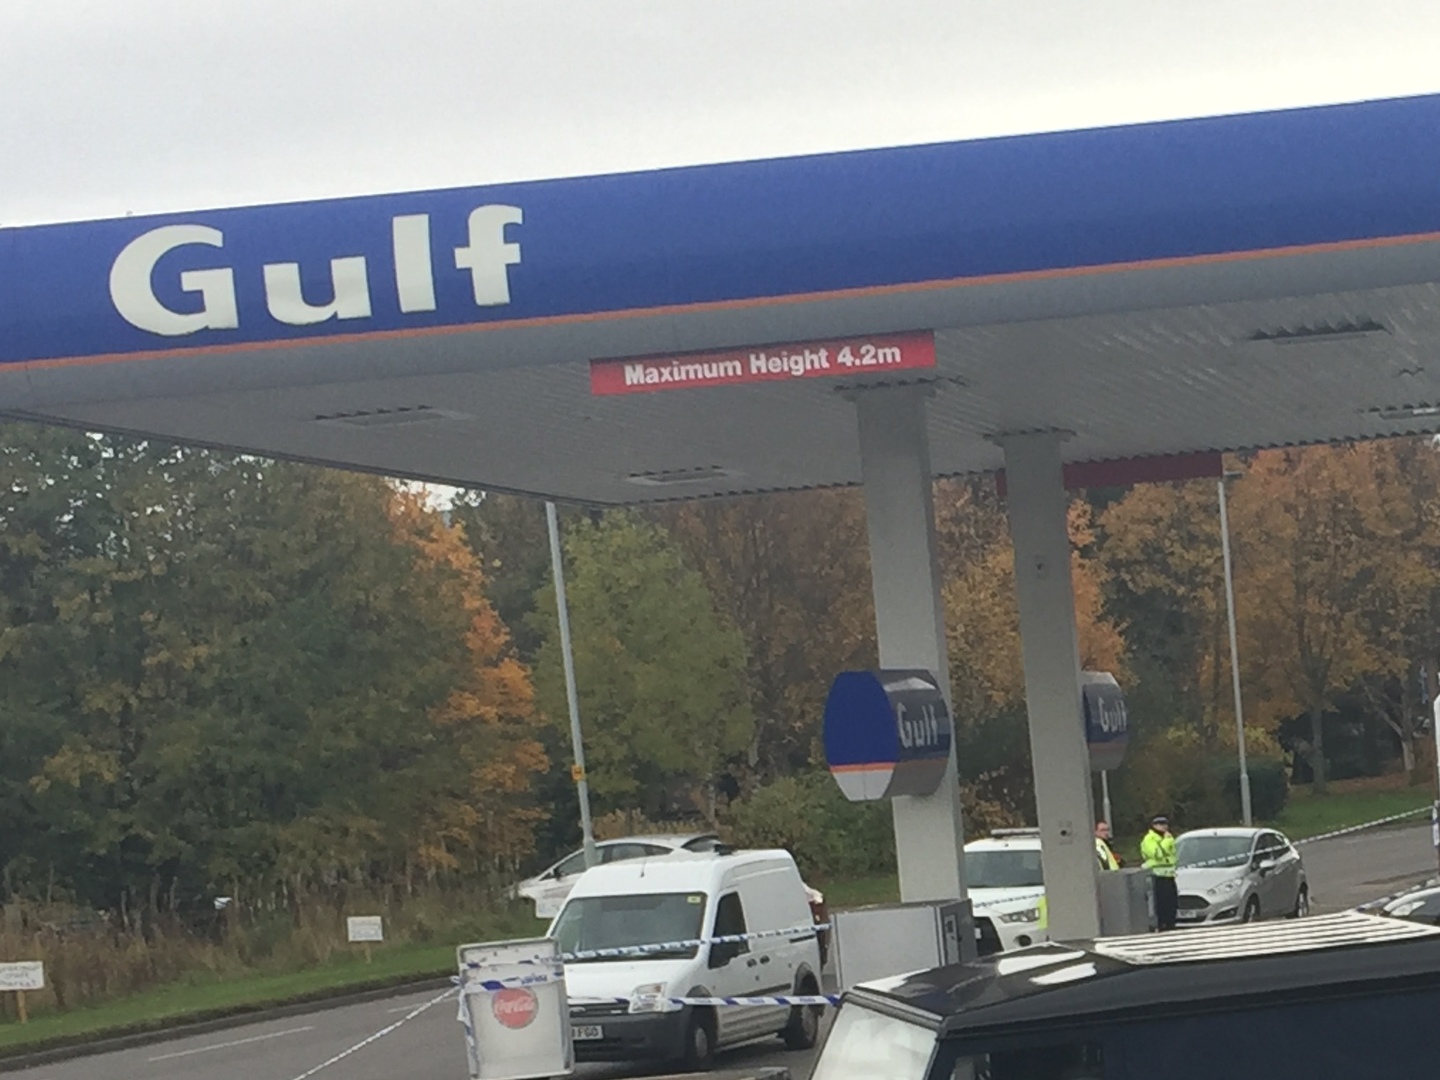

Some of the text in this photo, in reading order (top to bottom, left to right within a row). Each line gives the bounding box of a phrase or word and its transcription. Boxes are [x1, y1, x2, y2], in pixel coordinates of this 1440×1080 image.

[109, 204, 524, 337] Gulf
[624, 344, 901, 386] Maximum Height 4.2m
[897, 700, 938, 749] Gulf
[1098, 697, 1128, 733] Gulf
